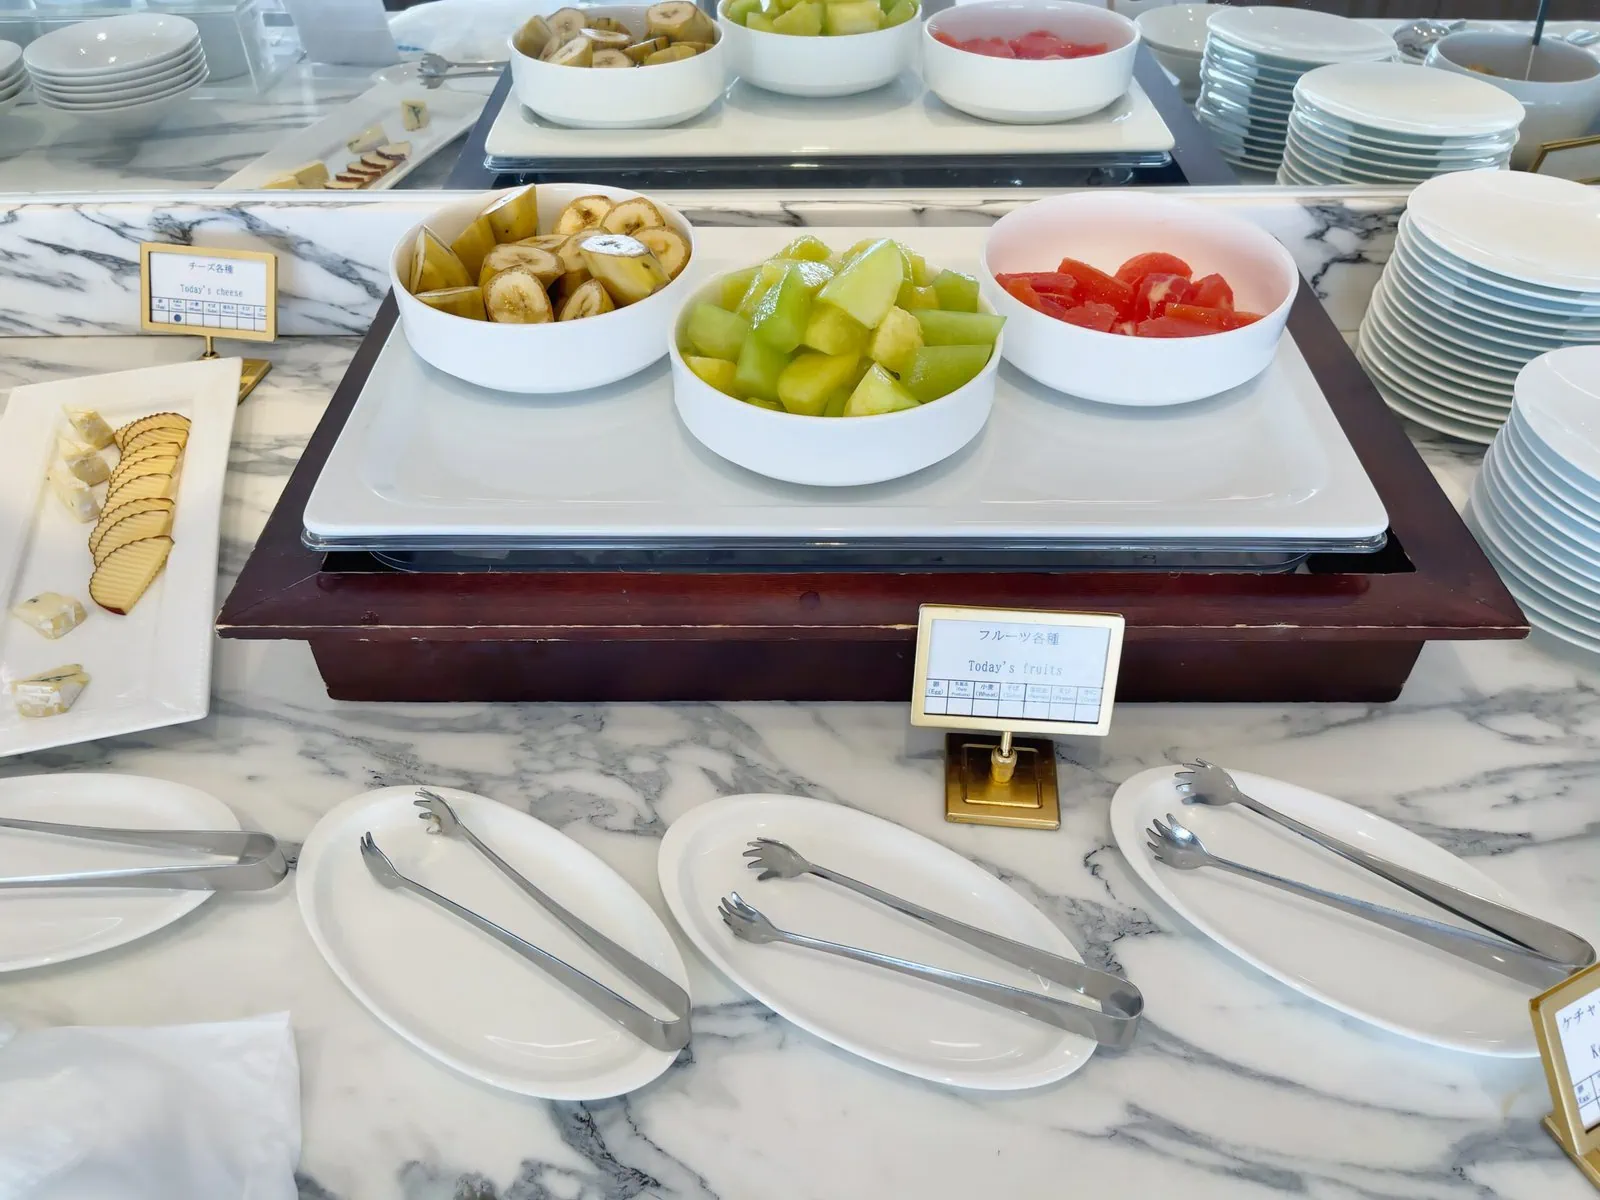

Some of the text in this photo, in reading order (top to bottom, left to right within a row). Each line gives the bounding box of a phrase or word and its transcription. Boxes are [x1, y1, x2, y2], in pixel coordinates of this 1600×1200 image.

[189, 262, 234, 274] チーズ各種
[180, 284, 243, 297] Today's cheese
[979, 630, 1060, 646] フルーツ各種
[968, 660, 1064, 676] Today's fruits
[1563, 1000, 1600, 1029] ケチャ
